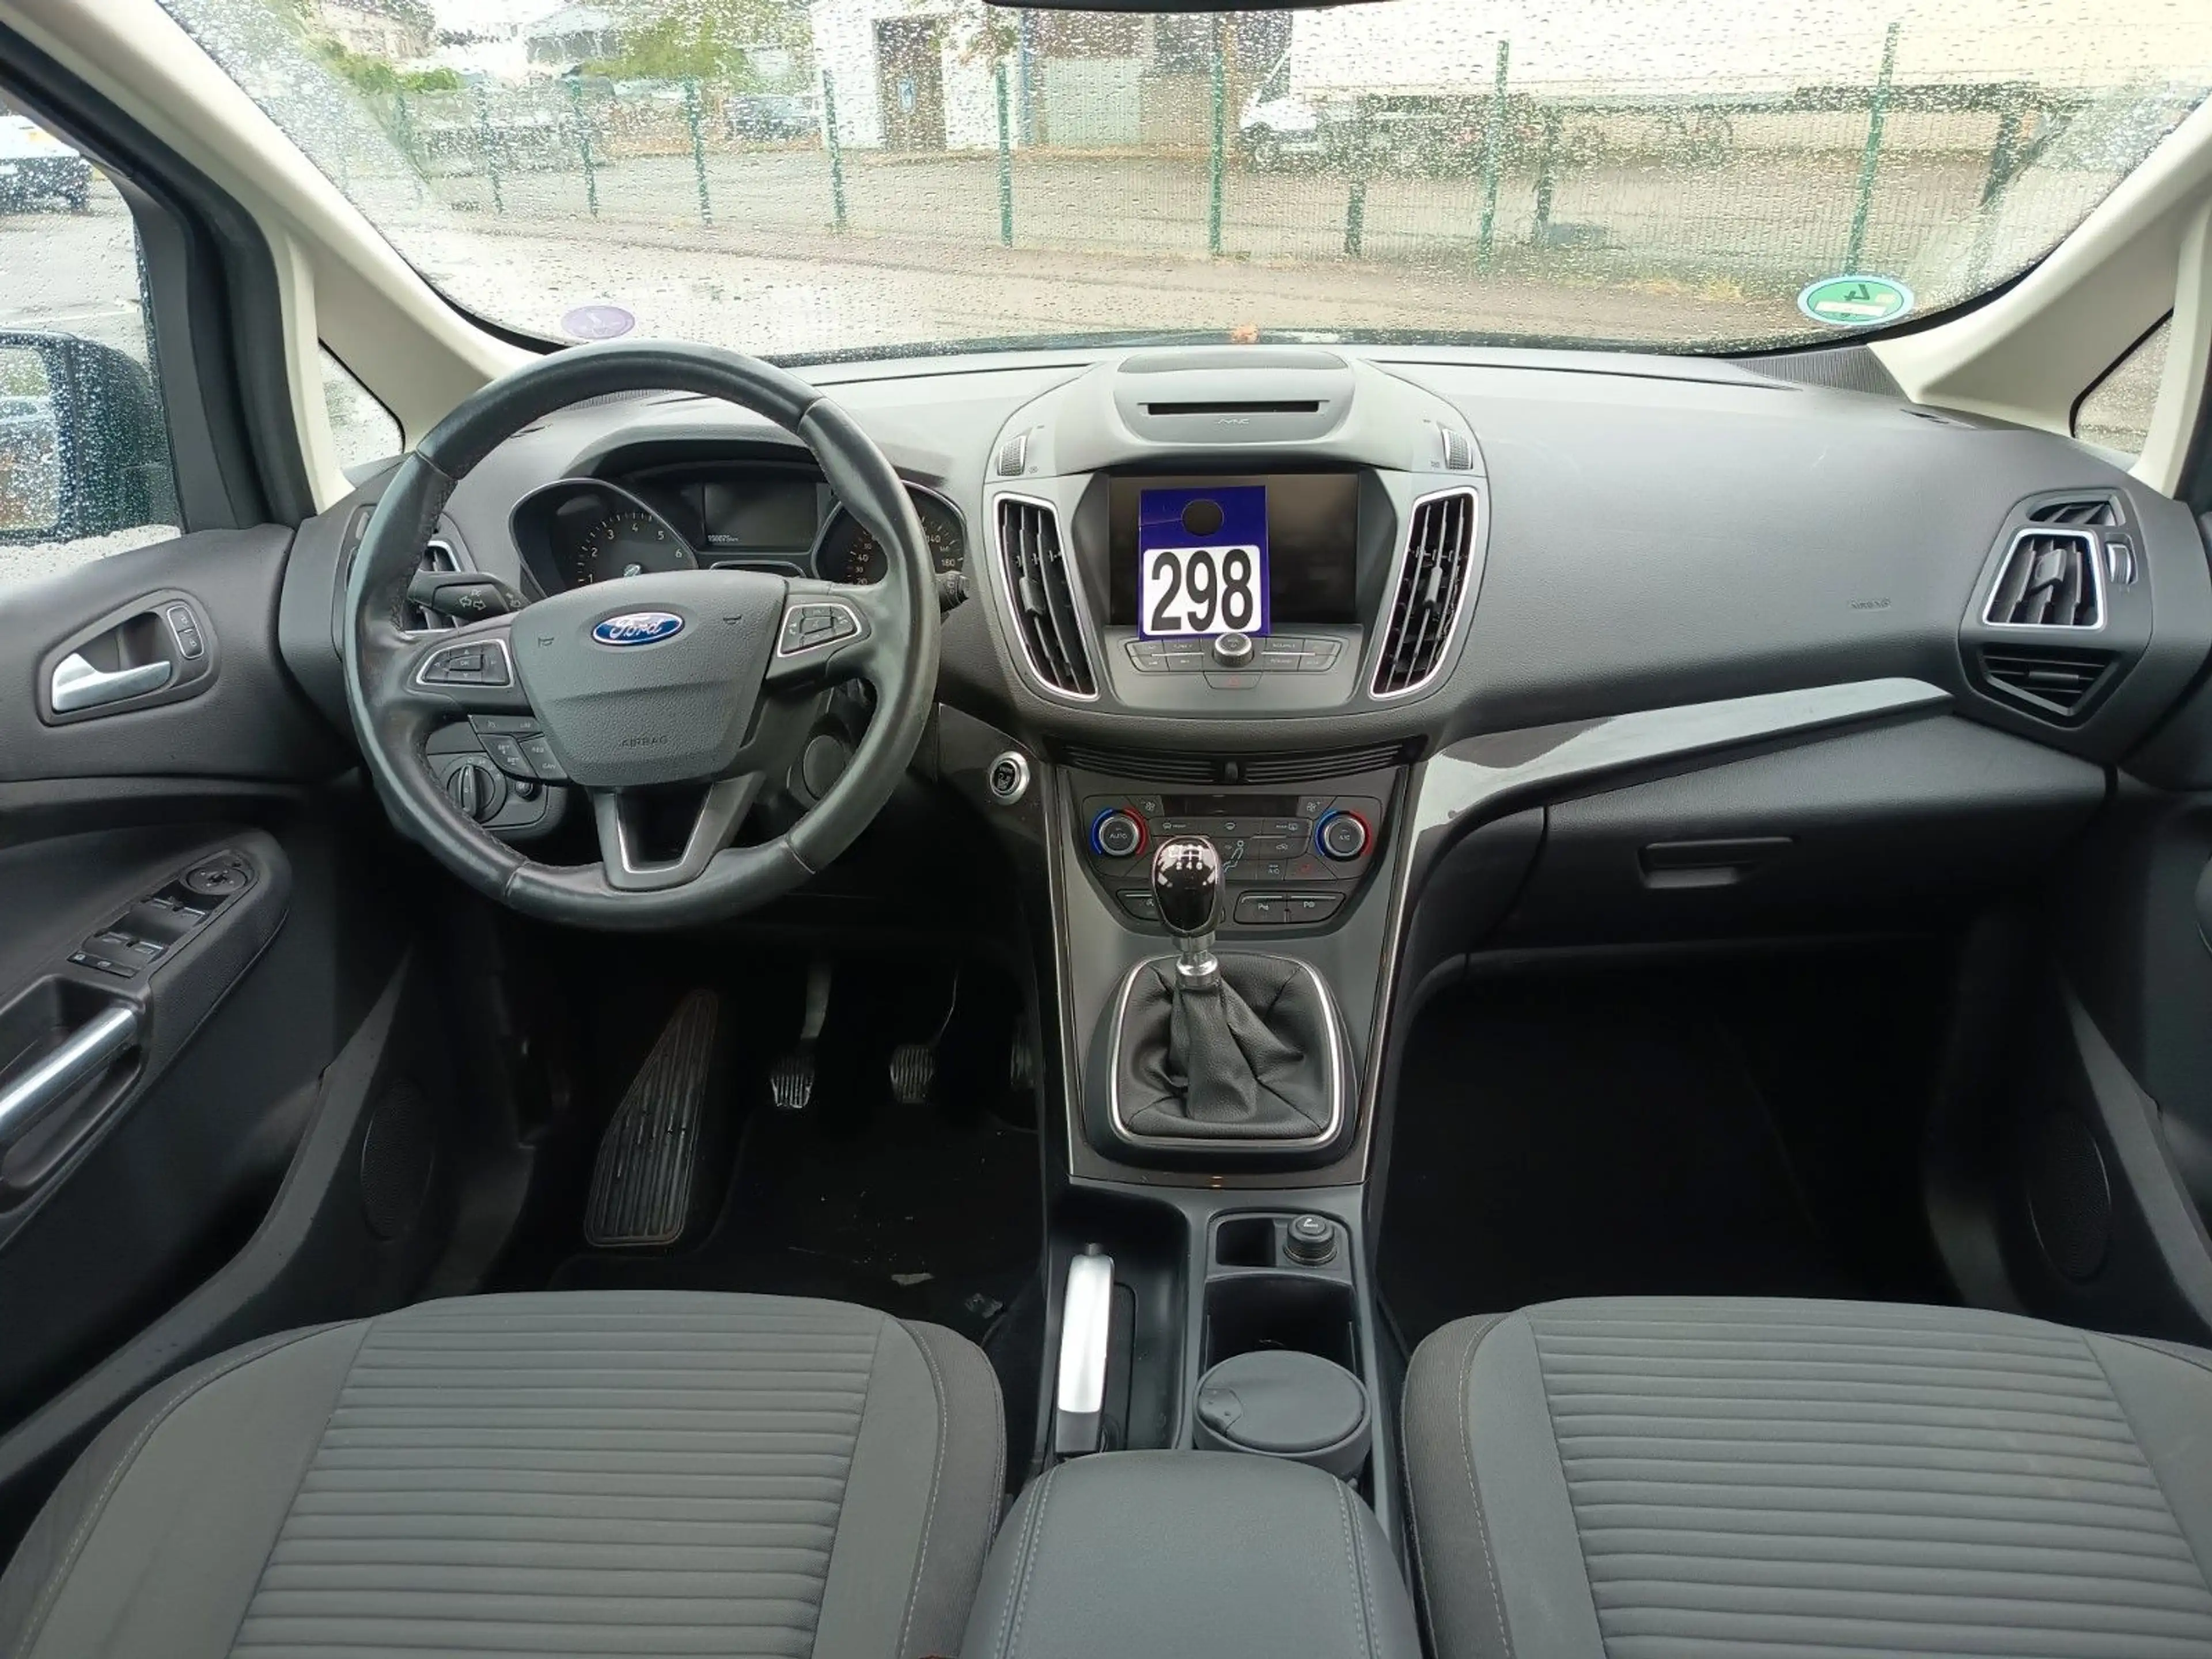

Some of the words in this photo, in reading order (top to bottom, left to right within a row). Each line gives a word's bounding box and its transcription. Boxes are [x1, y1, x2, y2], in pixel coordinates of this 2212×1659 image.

[632, 523, 638, 532] 4
[608, 529, 615, 540] 3
[658, 531, 664, 540] 5
[591, 547, 598, 557] 2
[675, 548, 682, 558] 6
[588, 574, 593, 584] 1
[1150, 548, 1253, 632] 298
[609, 615, 664, 639] Ford
